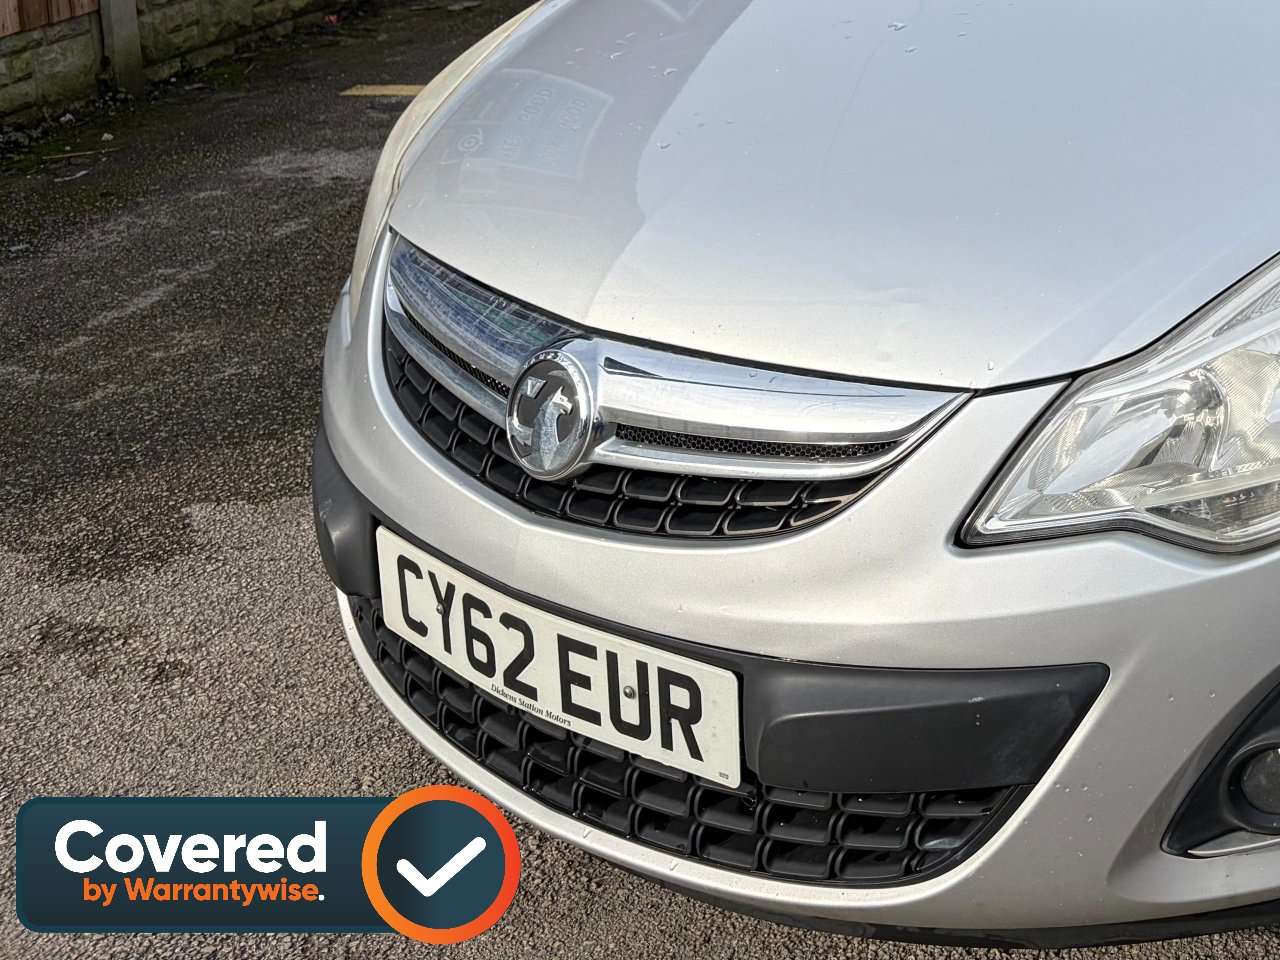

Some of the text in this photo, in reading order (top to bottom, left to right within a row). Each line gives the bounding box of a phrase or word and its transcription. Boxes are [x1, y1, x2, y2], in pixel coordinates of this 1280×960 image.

[396, 554, 705, 763] CY62 EUR
[518, 698, 544, 716] Station
[544, 709, 572, 727] Motors
